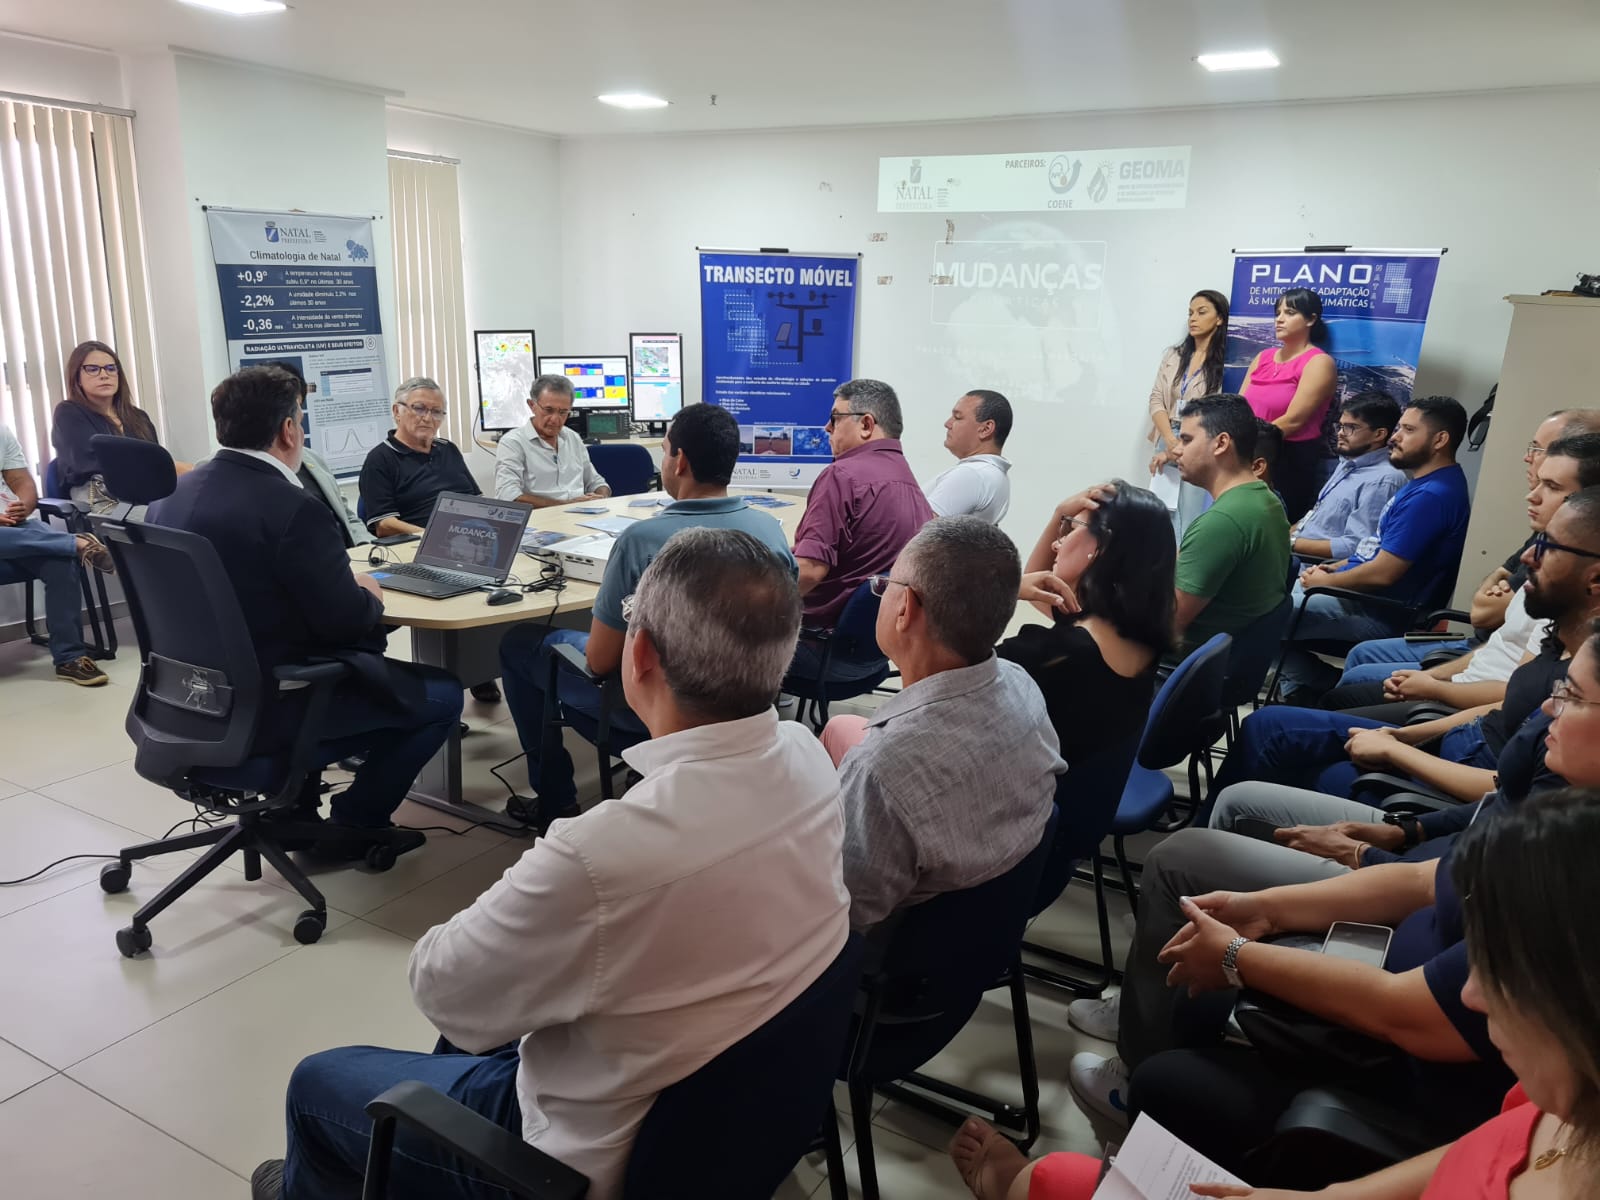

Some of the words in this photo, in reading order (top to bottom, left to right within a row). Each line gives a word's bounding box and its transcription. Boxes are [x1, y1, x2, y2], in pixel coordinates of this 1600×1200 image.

[1004, 159, 1046, 168] PARCEIROS:
[1119, 159, 1185, 180] GEOMA
[896, 185, 934, 200] NATAL
[1048, 199, 1073, 209] COENE
[280, 227, 312, 239] NATAL
[249, 250, 305, 262] Climatologia
[308, 252, 319, 261] de
[321, 252, 341, 262] Natal
[703, 265, 795, 284] TRANSECTO
[799, 265, 853, 287] MÓVEL
[934, 261, 1103, 295] MUDANÇAS
[1250, 263, 1374, 284] PLANO
[1250, 286, 1261, 296] DE
[1317, 285, 1370, 298] ADAPTAÇÃO
[240, 294, 275, 308] -2,2%
[1248, 295, 1260, 305] ÀS
[1320, 296, 1369, 308] LIMÁTICAS
[243, 317, 273, 332] -0,36
[246, 344, 276, 353] RADIAÇÃO
[277, 343, 316, 351] ULTRAVIOLETA
[449, 524, 498, 540] MUDANÇAS
